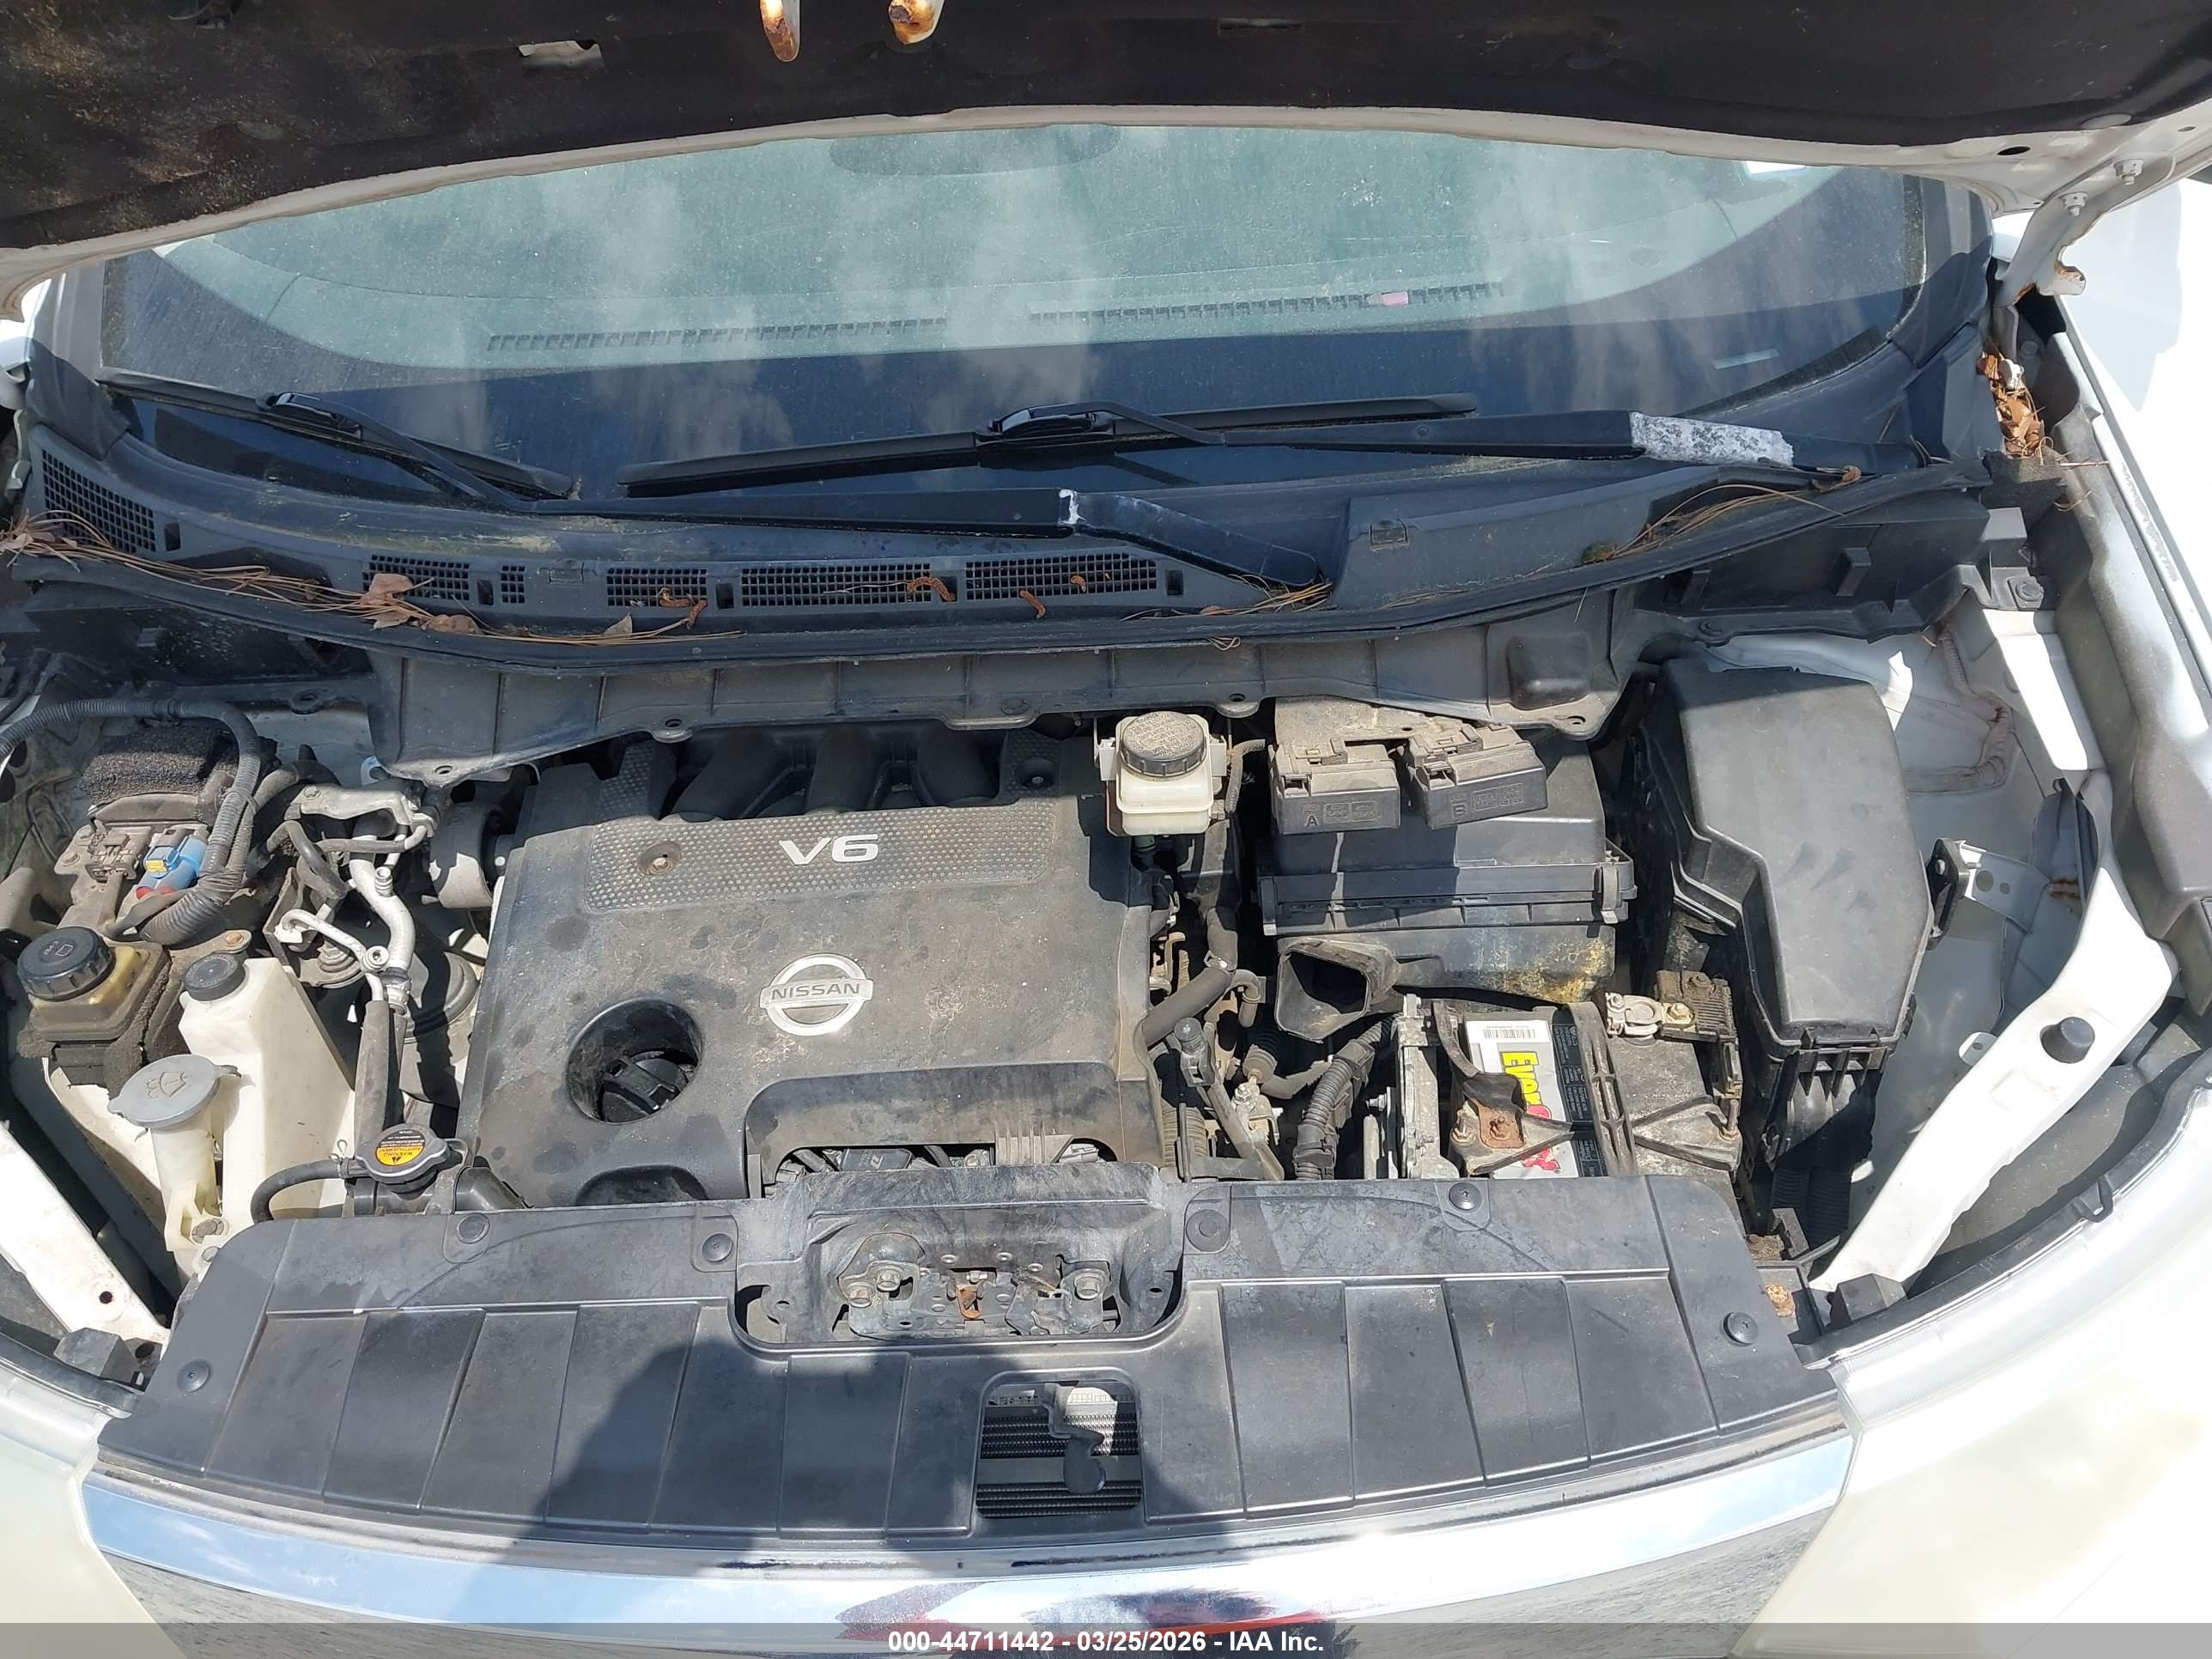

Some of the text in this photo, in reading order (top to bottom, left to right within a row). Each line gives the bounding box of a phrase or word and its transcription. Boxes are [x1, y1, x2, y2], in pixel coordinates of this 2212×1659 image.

[1305, 815, 1319, 827] A
[779, 834, 879, 865] V6
[771, 983, 861, 1000] NISSAN
